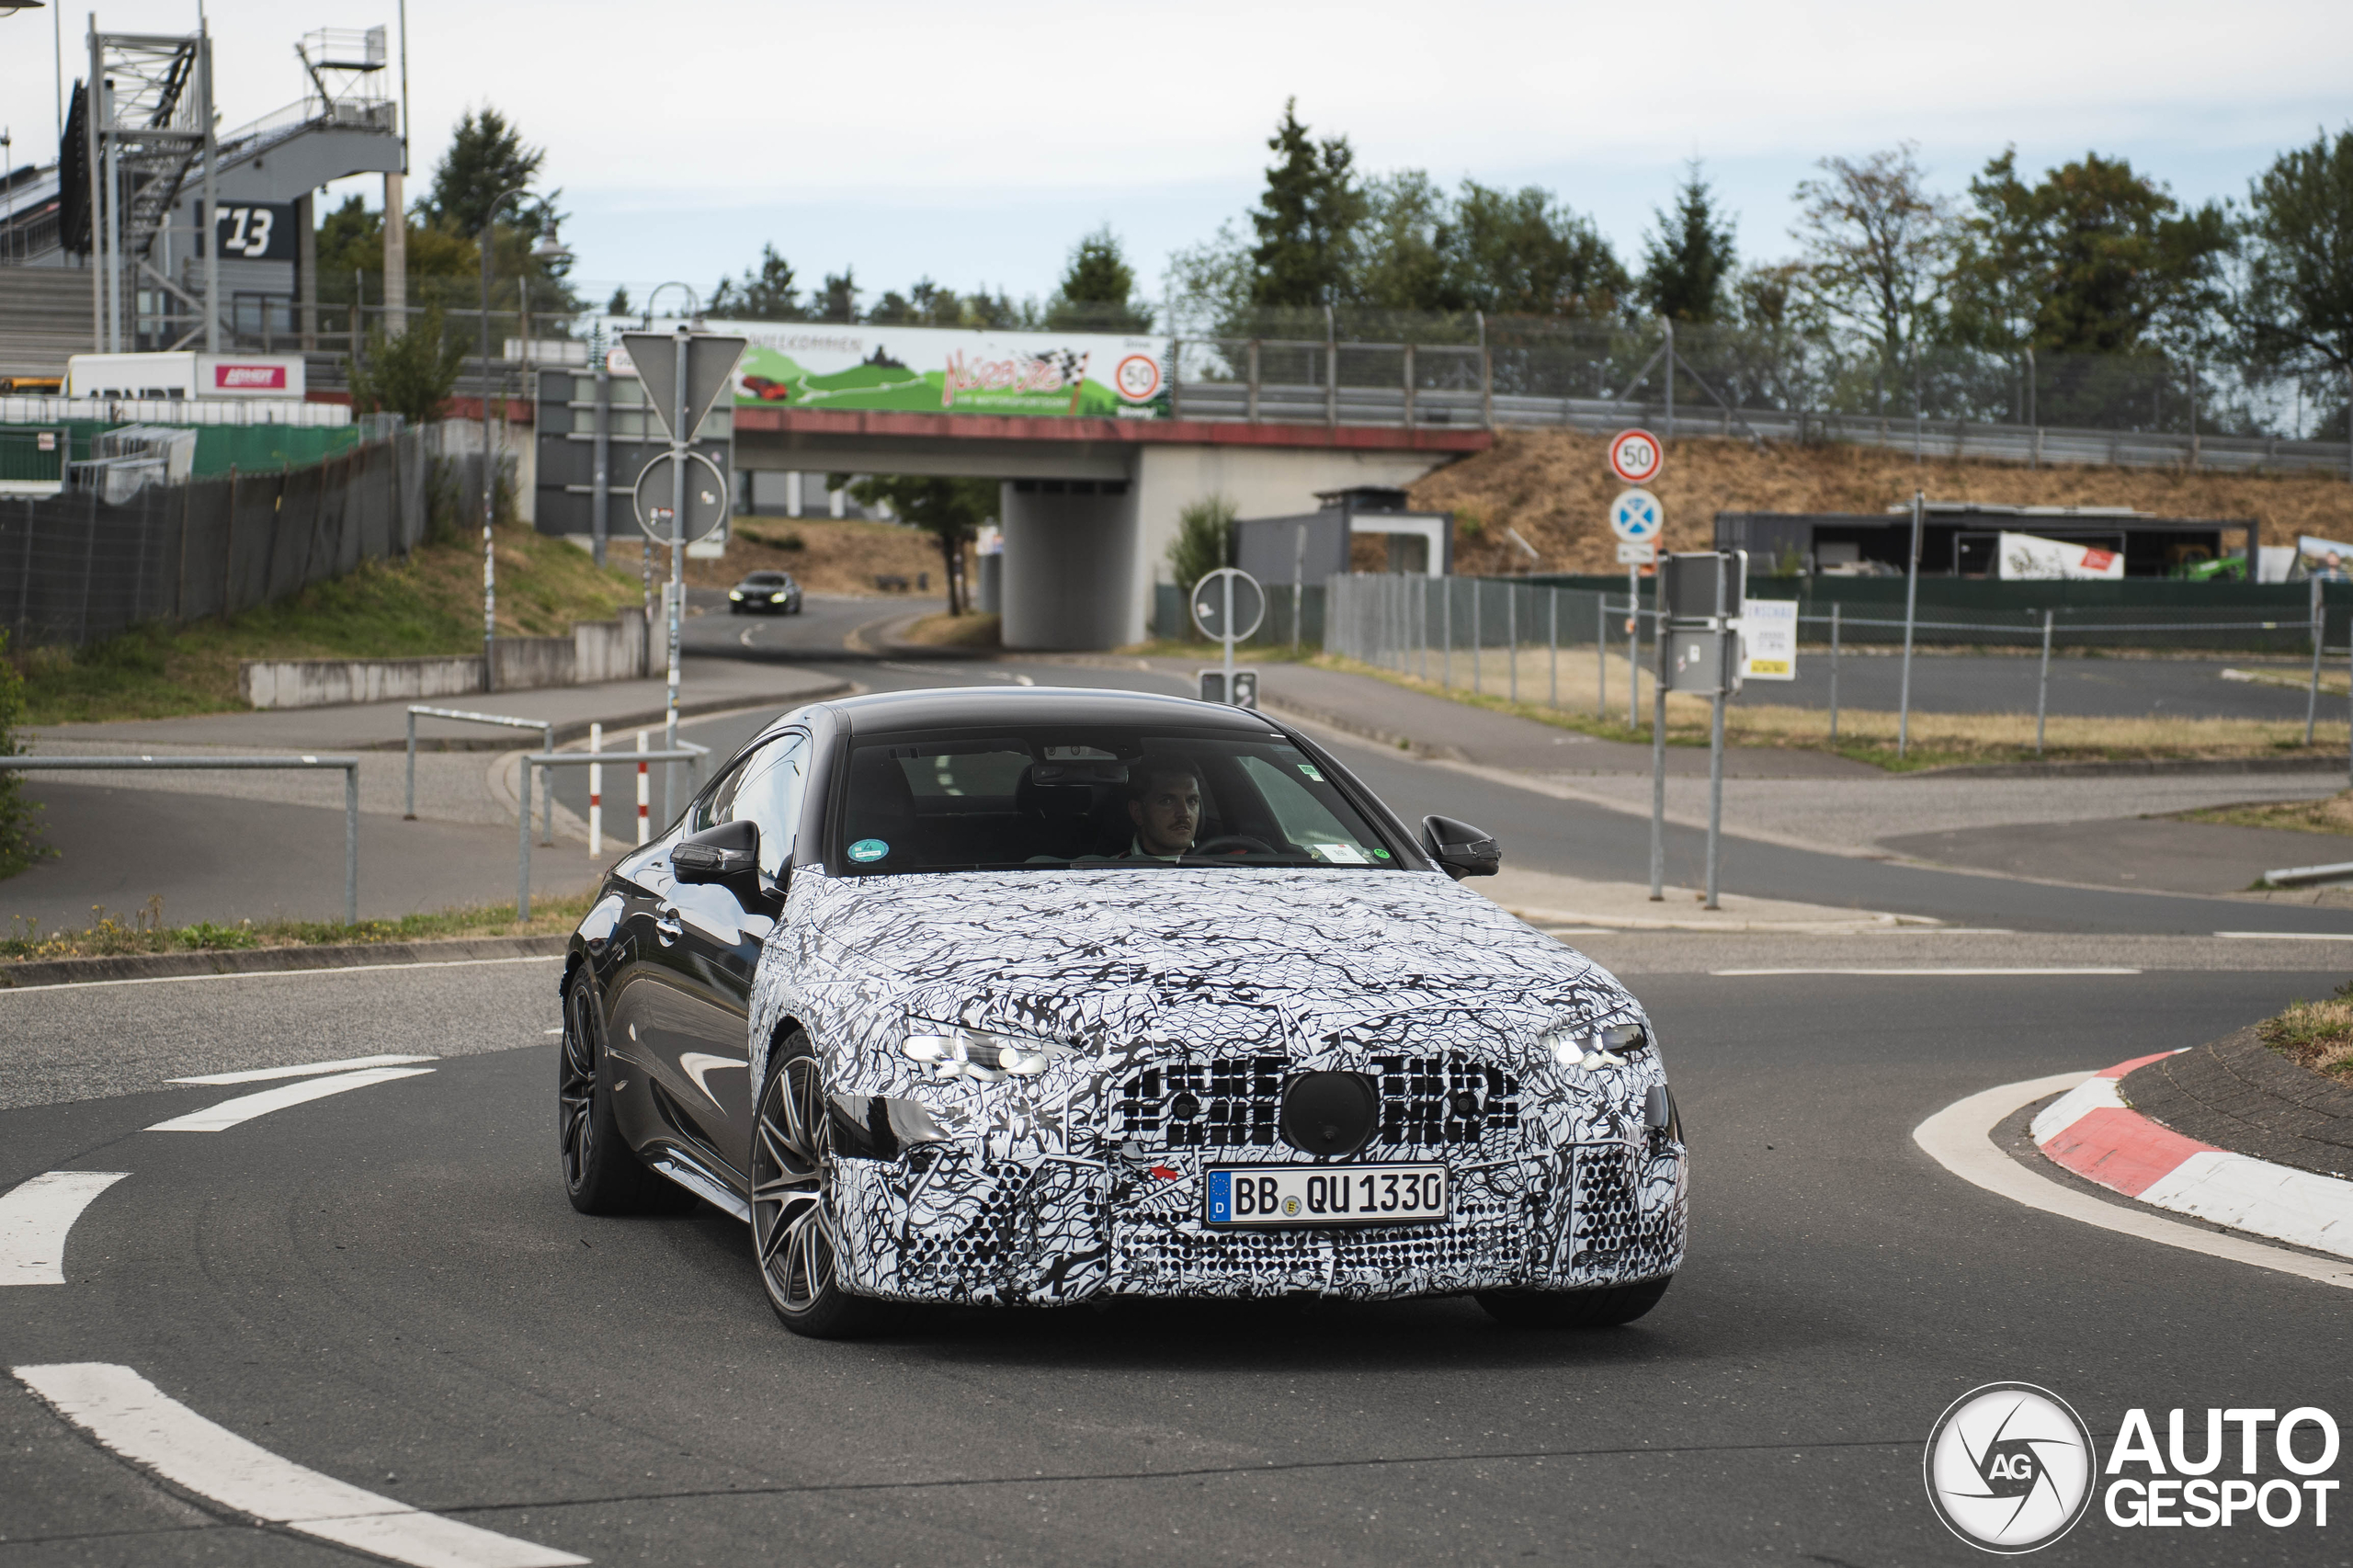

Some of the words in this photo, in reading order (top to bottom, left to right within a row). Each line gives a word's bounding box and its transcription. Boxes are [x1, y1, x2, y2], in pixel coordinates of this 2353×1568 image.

[1126, 366, 1149, 387] 50
[1623, 445, 1651, 467] 50
[1235, 1177, 1279, 1215] BB
[1307, 1176, 1349, 1213] QU
[1359, 1173, 1441, 1212] 1330
[1215, 1201, 1224, 1213] D
